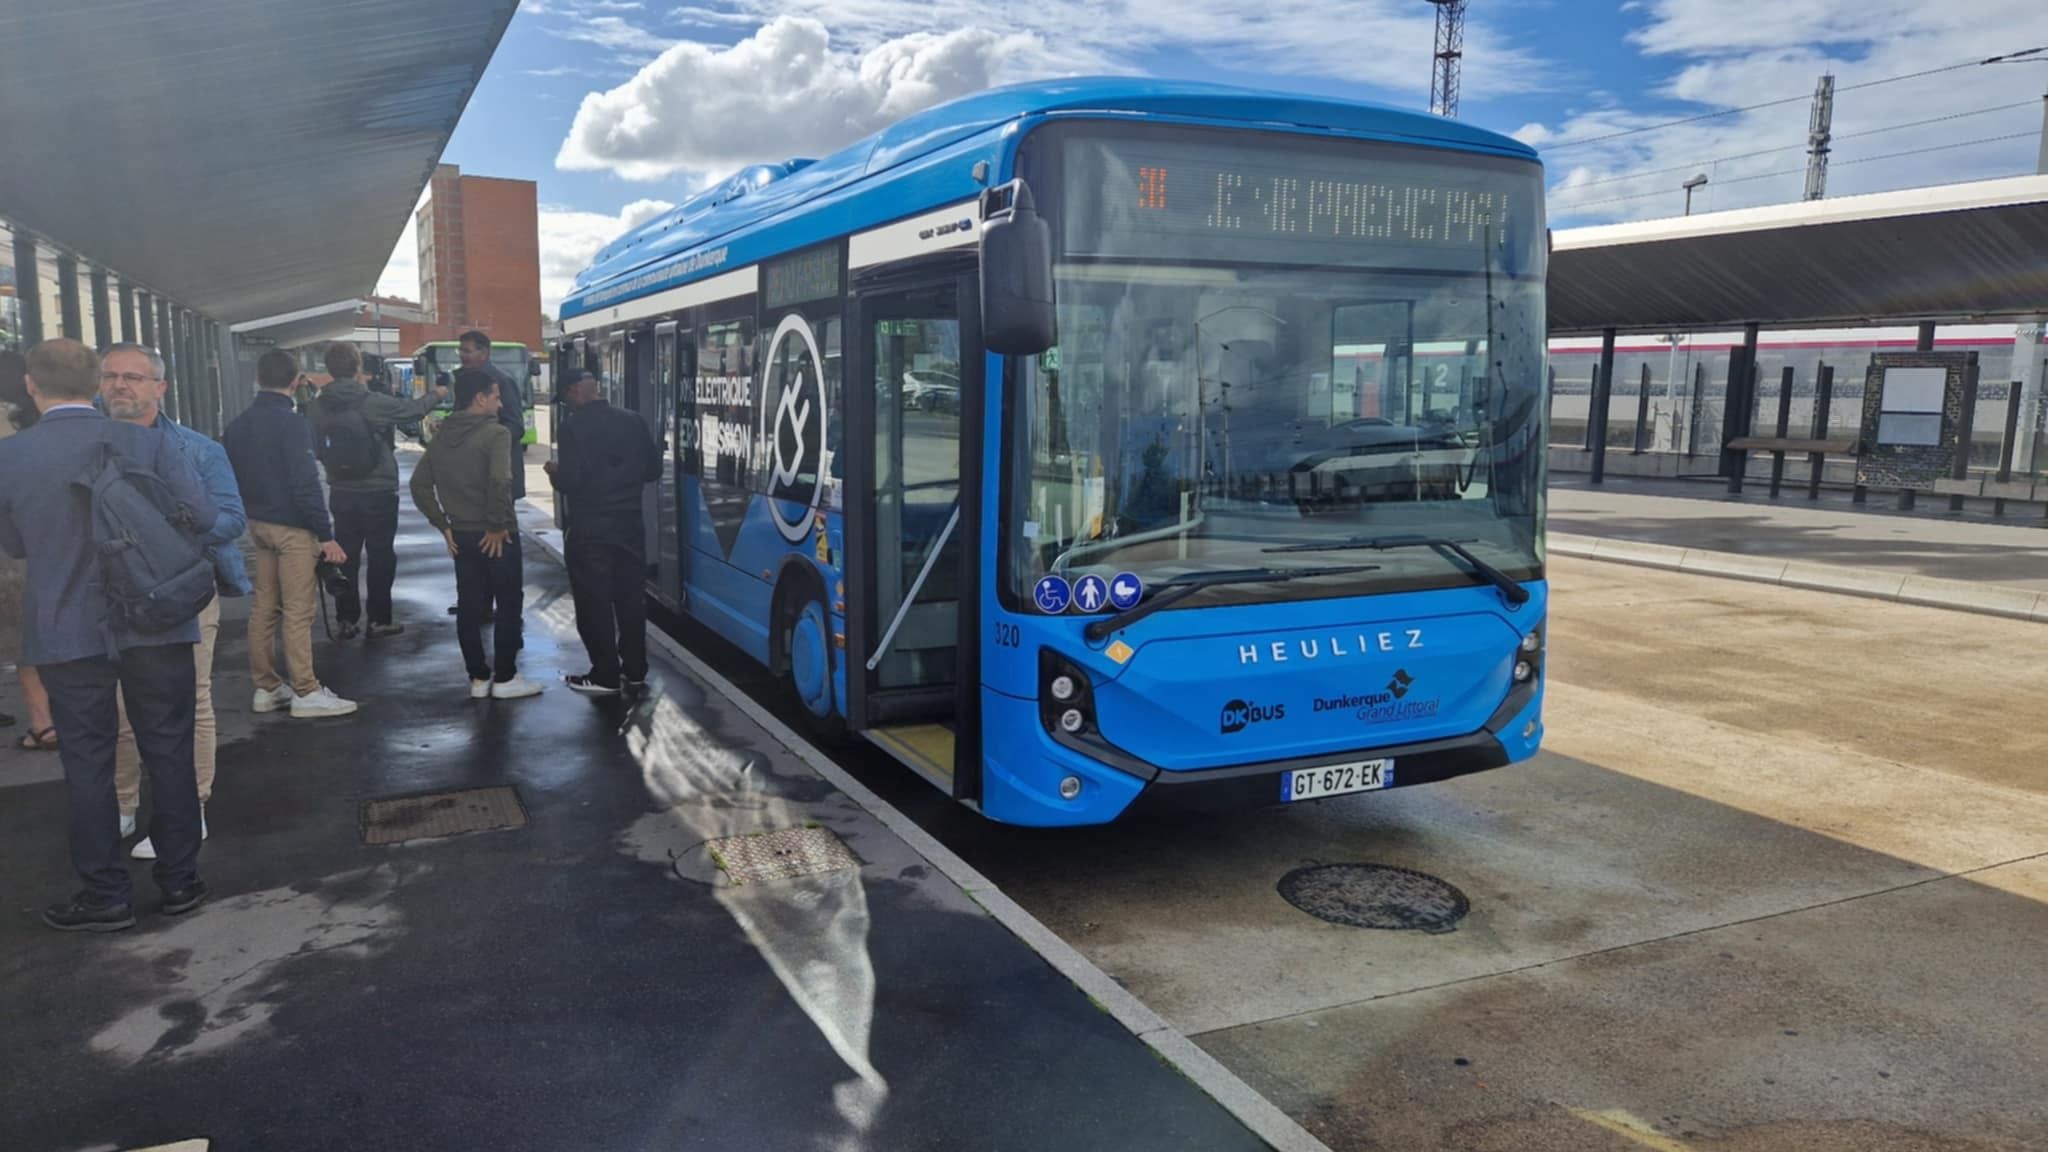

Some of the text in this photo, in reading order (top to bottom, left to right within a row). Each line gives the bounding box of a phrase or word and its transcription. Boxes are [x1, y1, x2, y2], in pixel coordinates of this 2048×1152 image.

[1434, 363, 1449, 387] 2
[994, 622, 1020, 648] 320
[1239, 629, 1424, 664] HEULIEZ
[1313, 690, 1391, 713] Dunkerque
[1356, 702, 1395, 721] Grand
[1397, 696, 1440, 716] Littoral
